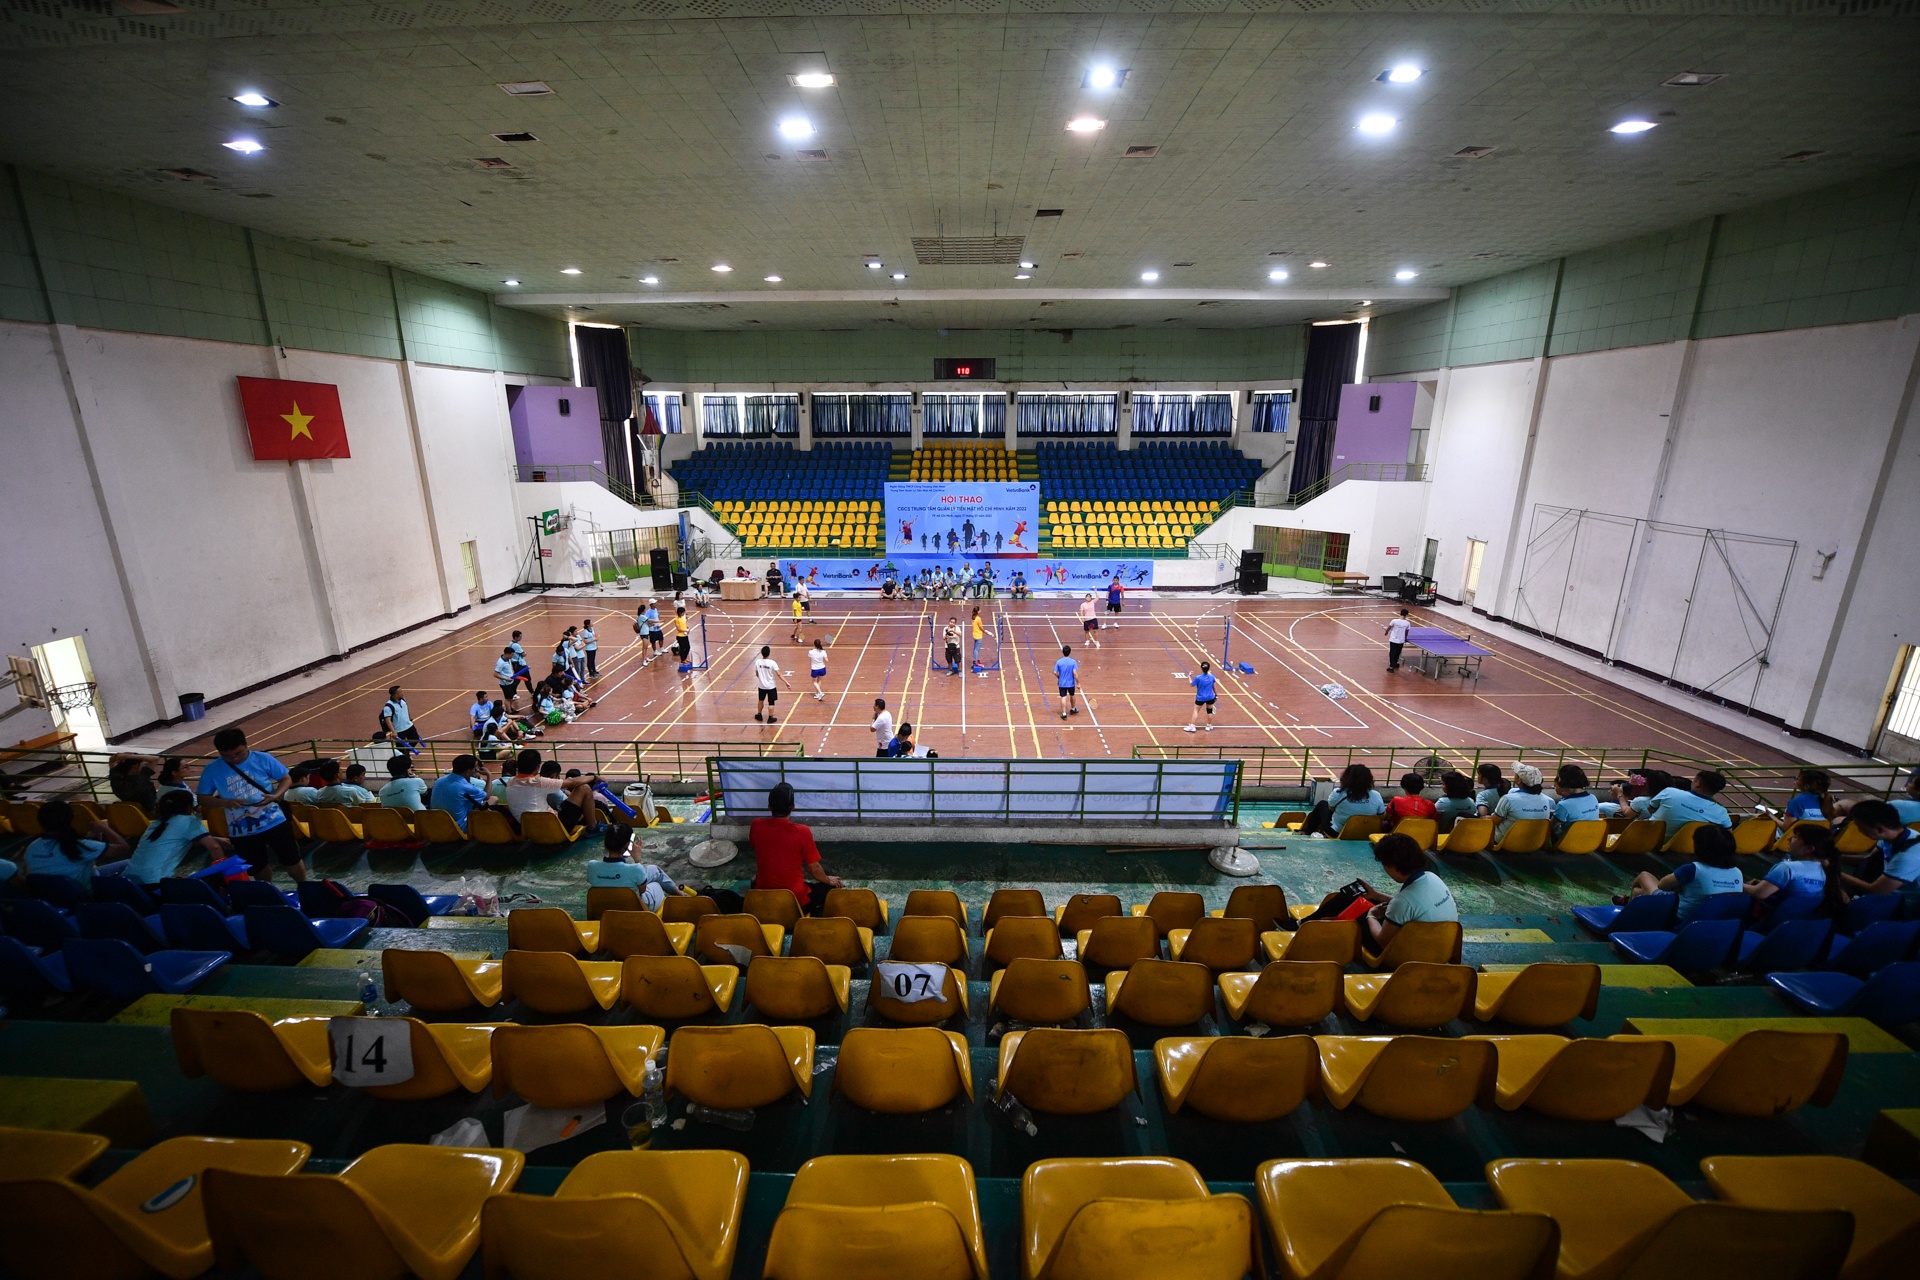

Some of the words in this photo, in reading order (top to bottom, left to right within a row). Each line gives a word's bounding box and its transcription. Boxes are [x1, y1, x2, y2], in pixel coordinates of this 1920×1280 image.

[957, 367, 970, 375] 110
[942, 494, 956, 505] HỘI
[895, 973, 932, 996] 07
[344, 1034, 388, 1074] 14
